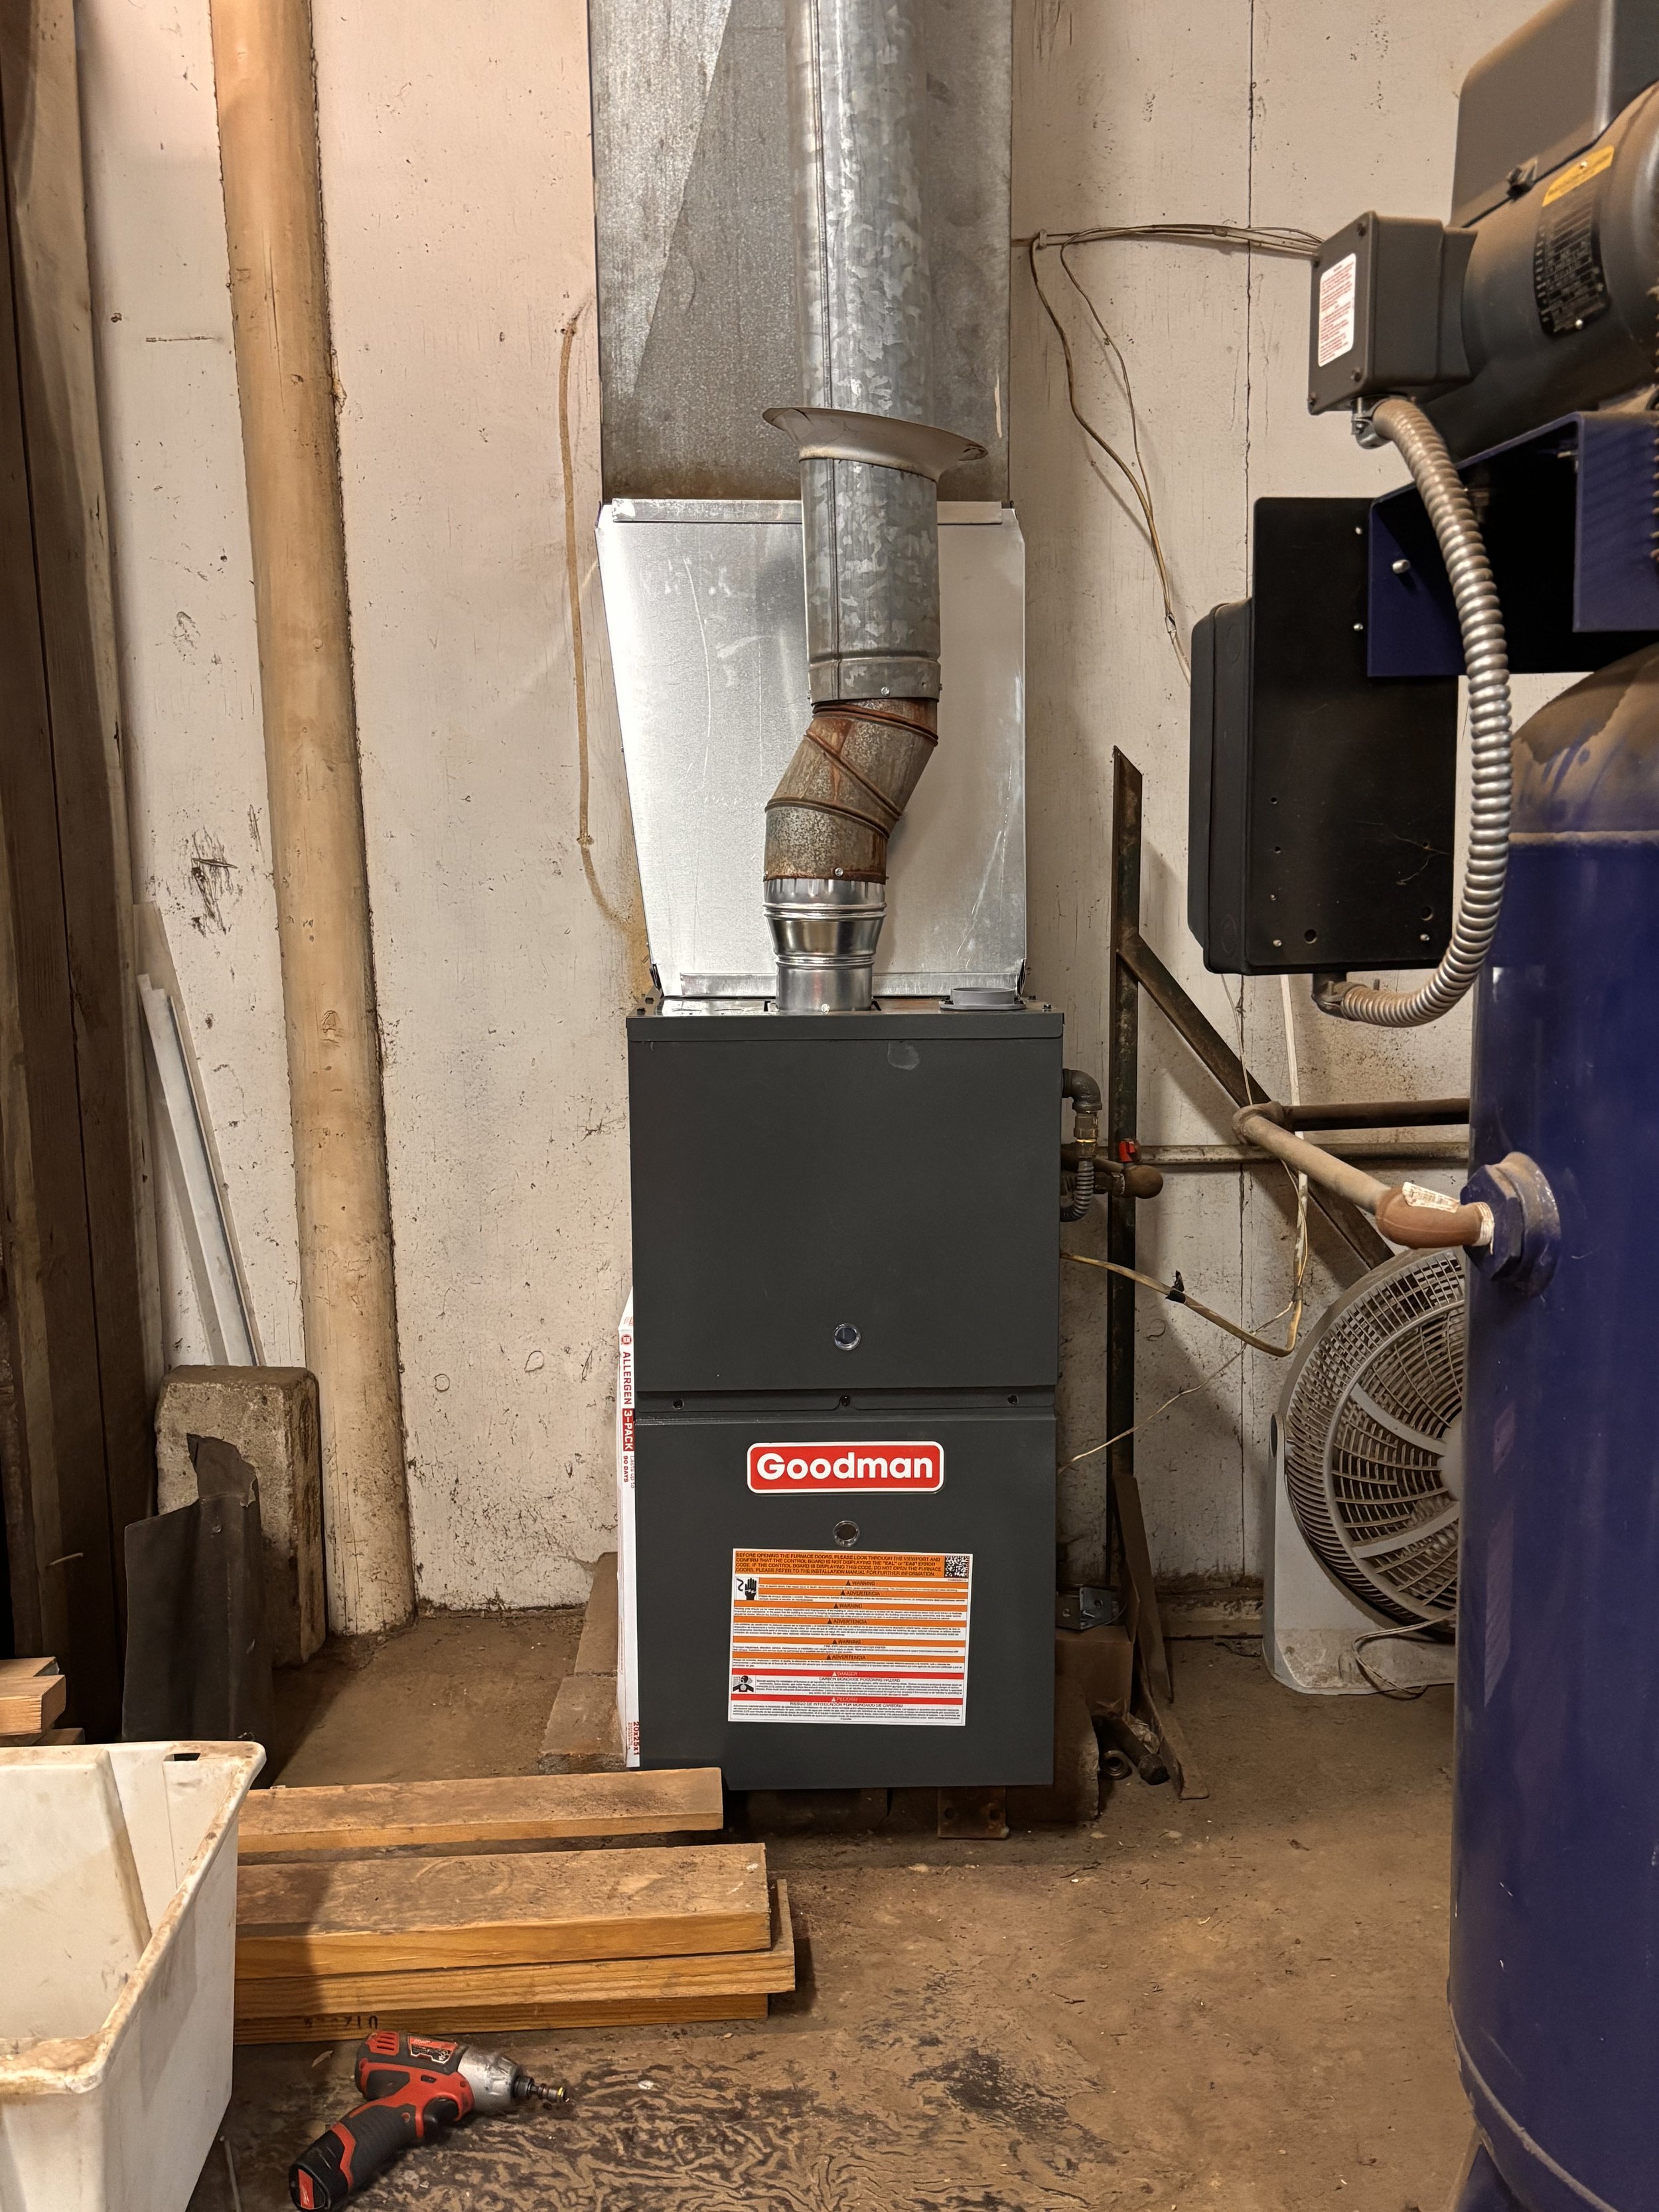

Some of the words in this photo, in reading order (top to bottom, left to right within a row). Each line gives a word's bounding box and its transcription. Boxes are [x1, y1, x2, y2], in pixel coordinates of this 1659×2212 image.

[623, 1352, 632, 1404] ALLERGEN
[624, 1410, 633, 1451] 3-PACK
[624, 1455, 628, 1464] 90
[757, 1452, 933, 1480] Goodman
